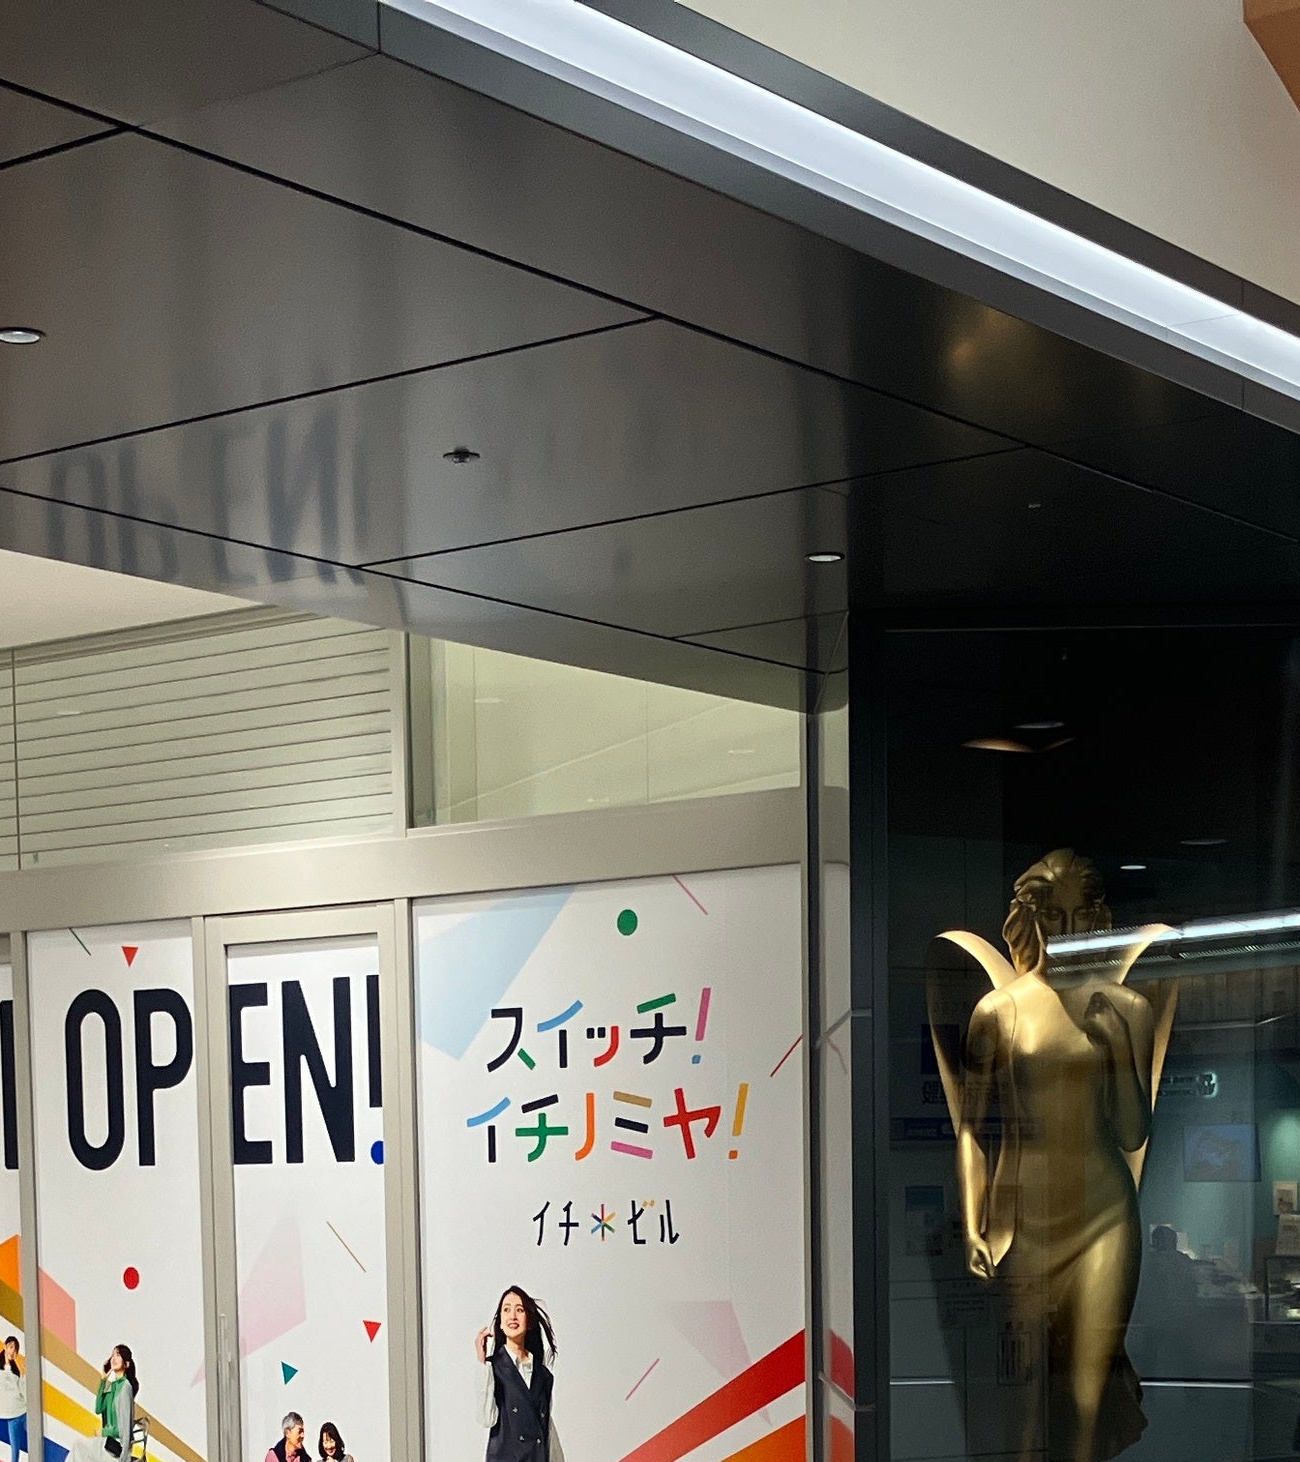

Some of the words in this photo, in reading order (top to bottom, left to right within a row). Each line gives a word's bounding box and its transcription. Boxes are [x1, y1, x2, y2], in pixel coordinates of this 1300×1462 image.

[65, 975, 384, 1170] OPEN!
[487, 987, 711, 1073] スイッチ!
[467, 1083, 749, 1163] イチノミヤ!
